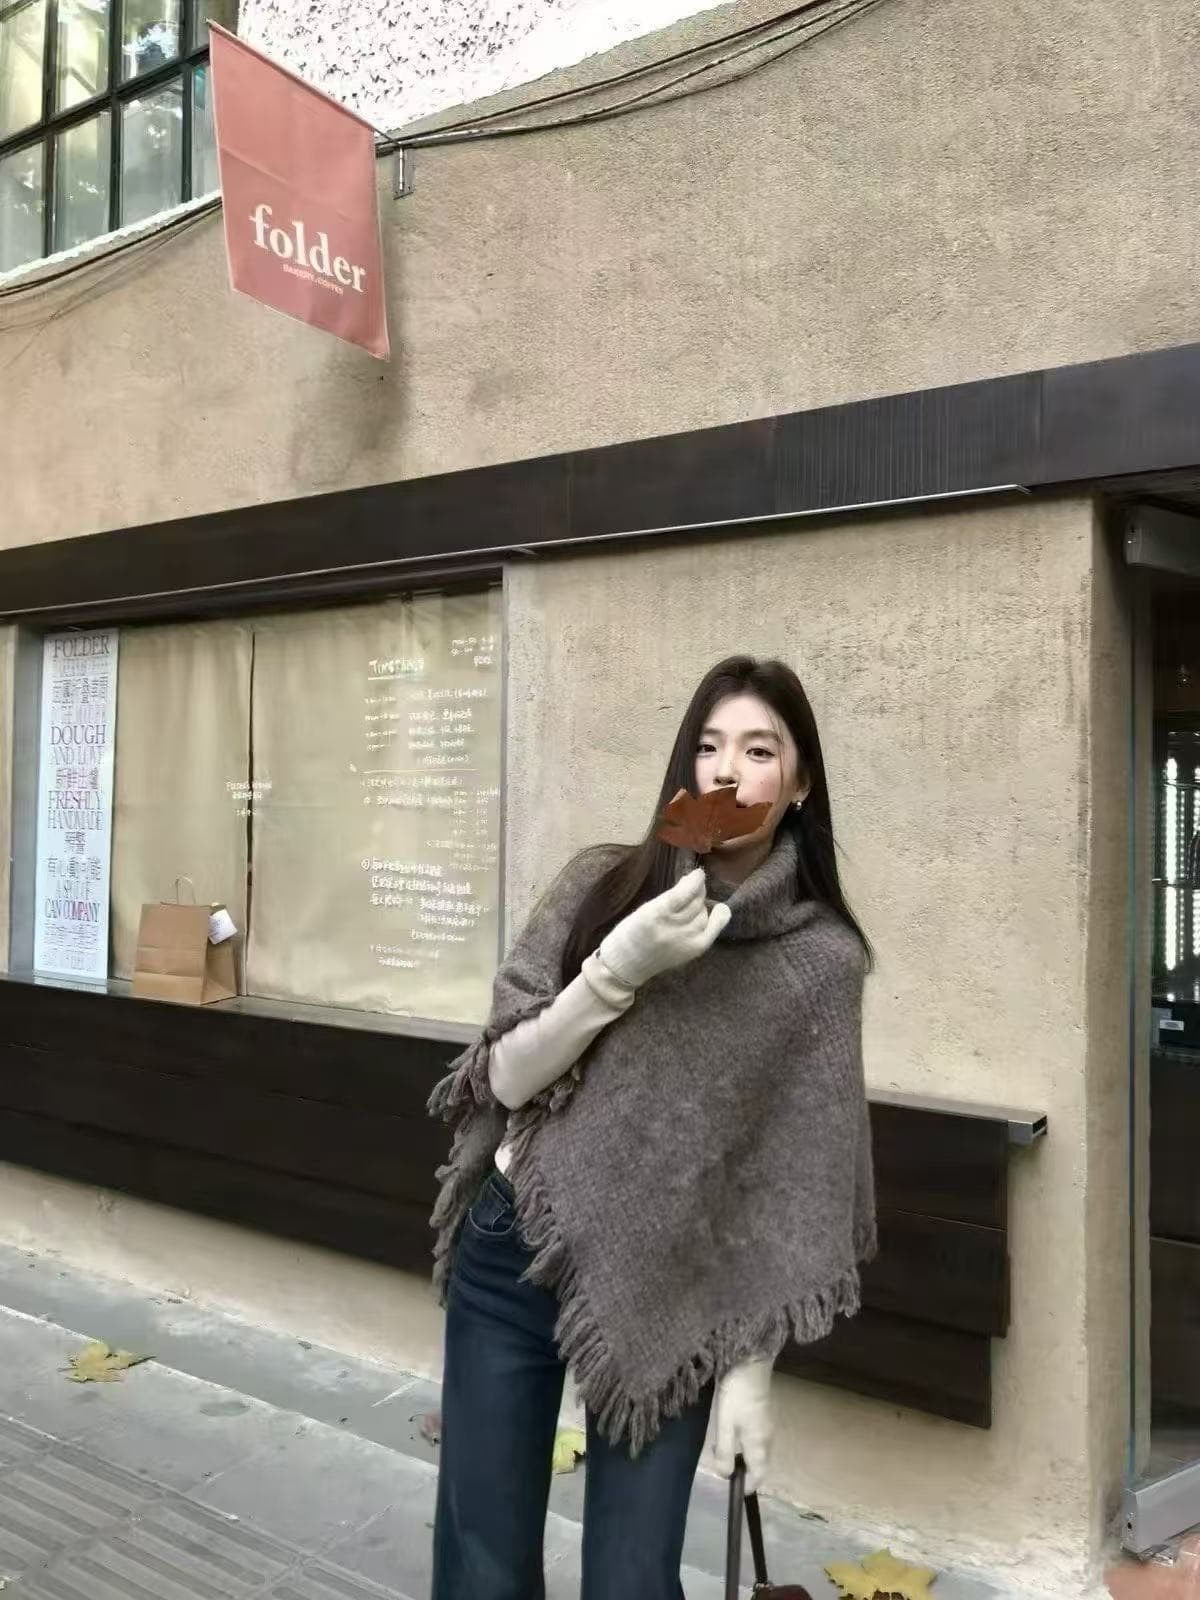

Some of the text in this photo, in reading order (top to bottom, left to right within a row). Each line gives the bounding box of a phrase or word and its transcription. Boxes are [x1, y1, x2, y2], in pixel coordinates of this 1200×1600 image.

[249, 203, 366, 293] folder
[53, 635, 110, 658] FOLDER
[50, 724, 106, 745] DOUGH
[48, 790, 103, 810] FRESHLY
[47, 809, 103, 831] HANDMADE
